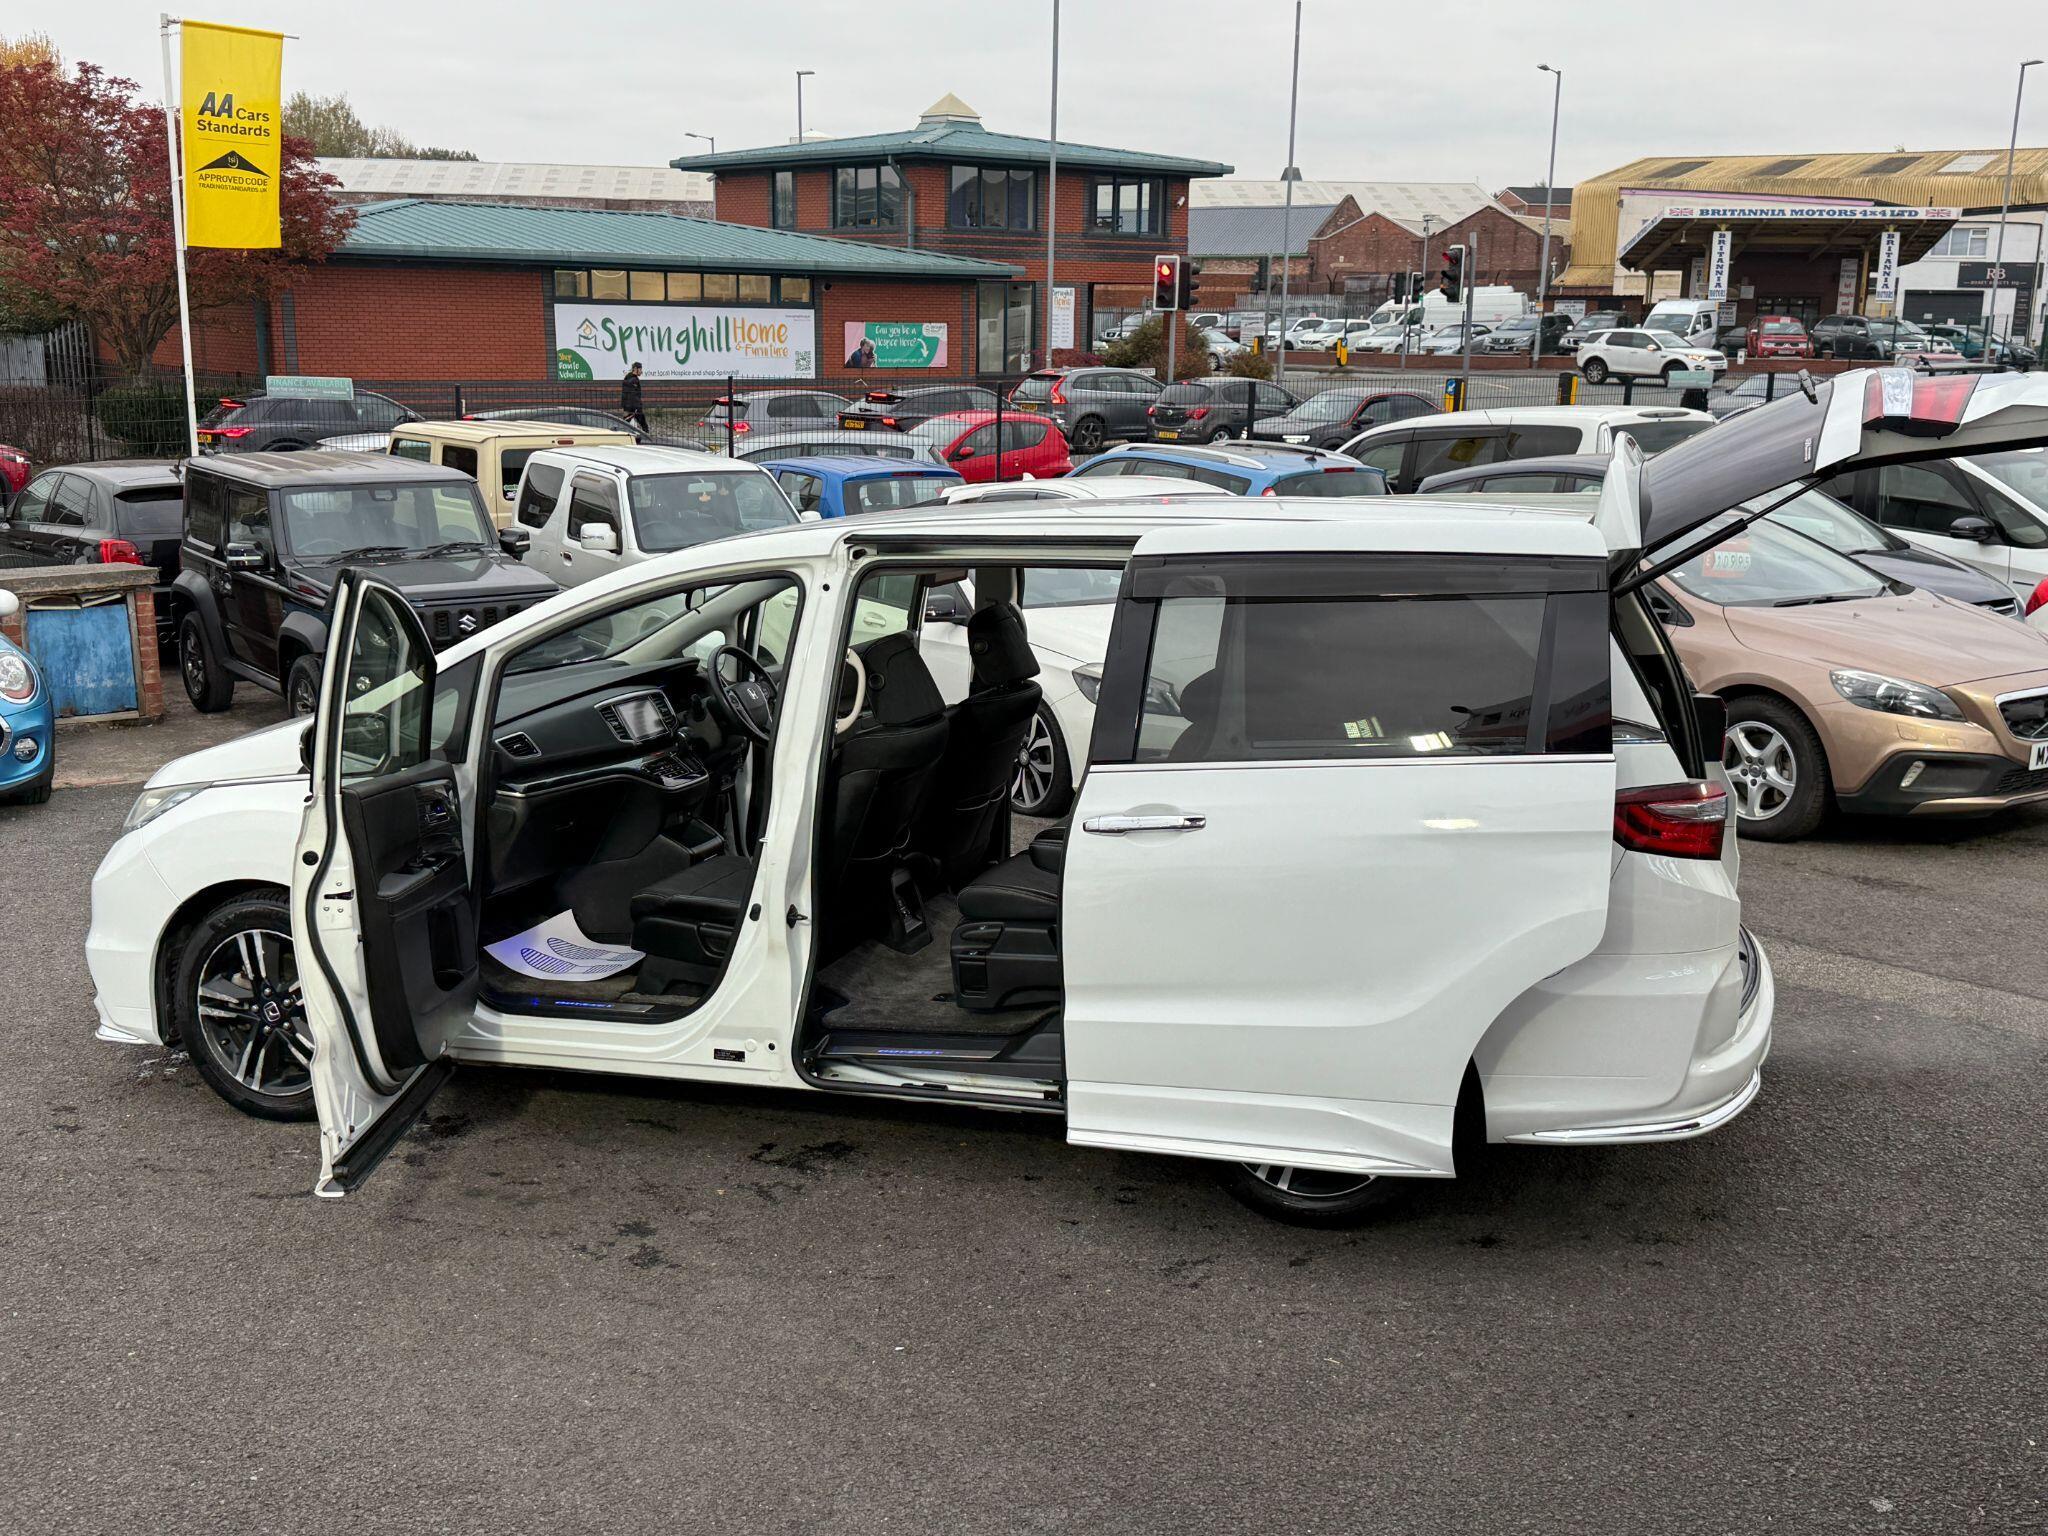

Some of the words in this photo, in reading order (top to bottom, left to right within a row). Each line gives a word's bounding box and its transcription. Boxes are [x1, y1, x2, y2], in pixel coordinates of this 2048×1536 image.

[198, 92, 233, 118] AA
[236, 108, 269, 122] Cars
[197, 119, 270, 137] Standards
[199, 174, 244, 184] APPROVED
[245, 177, 268, 186] CODE
[1699, 208, 1788, 217] BRITANNIA
[1790, 209, 1857, 217] MOTORS
[1714, 233, 1726, 288] BRITANNIA
[1881, 233, 1895, 289] BRITANNIA
[889, 327, 901, 337] you
[601, 315, 731, 365] Springhill
[733, 317, 788, 343] Home
[745, 343, 789, 357] Furniture
[671, 369, 692, 377] Hospice
[268, 377, 303, 387] FINANCE
[305, 378, 351, 388] AVAILABLE
